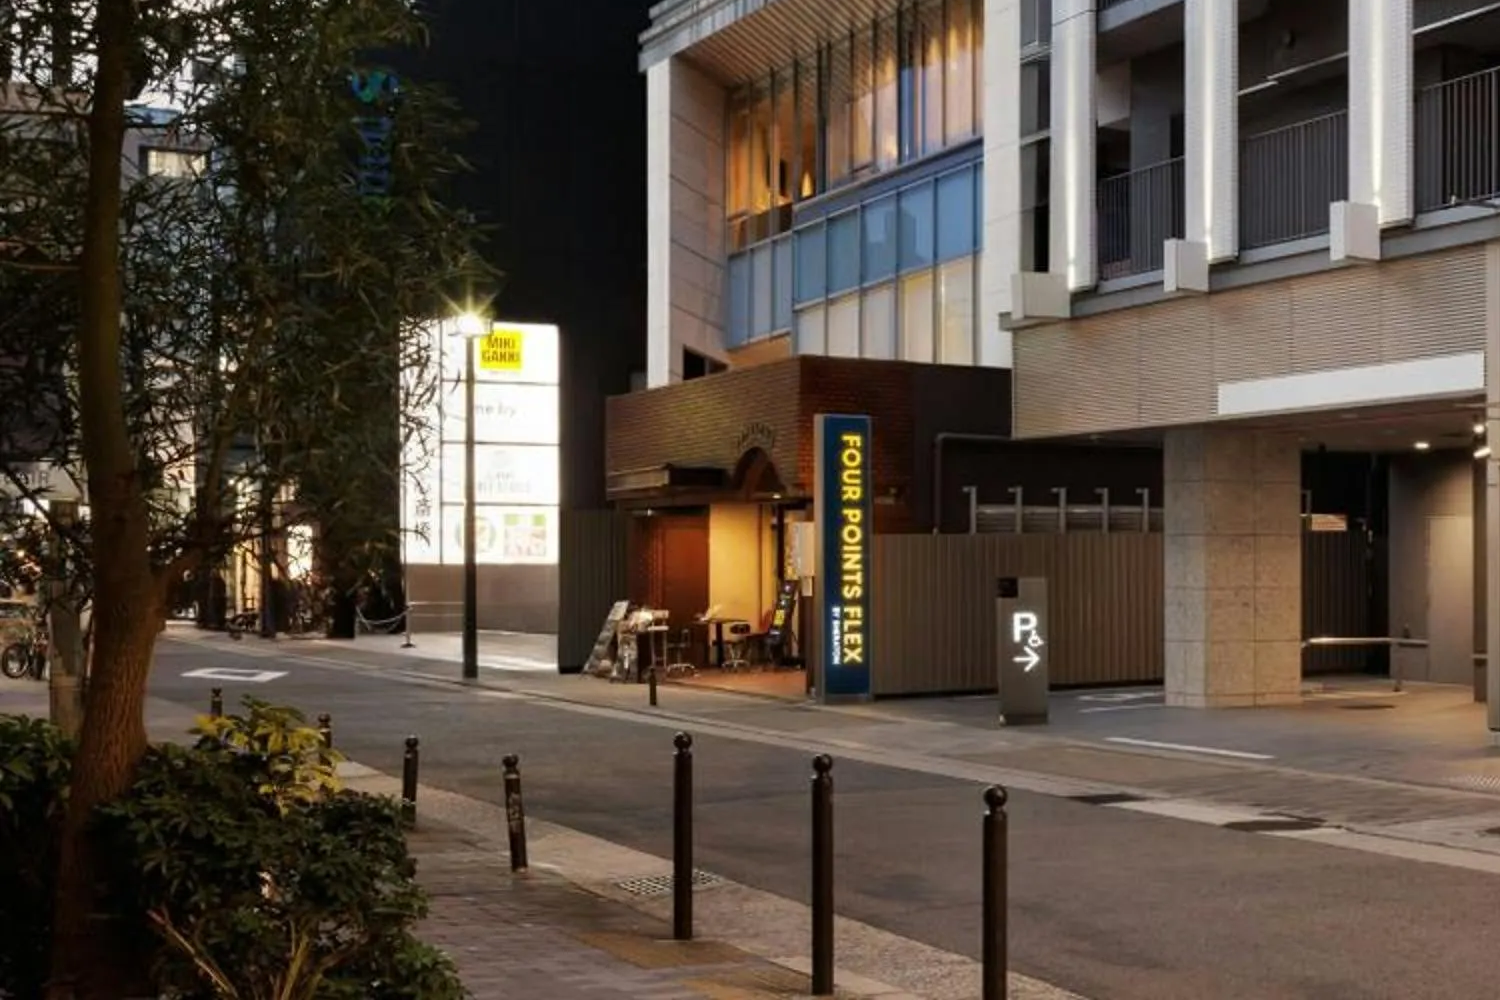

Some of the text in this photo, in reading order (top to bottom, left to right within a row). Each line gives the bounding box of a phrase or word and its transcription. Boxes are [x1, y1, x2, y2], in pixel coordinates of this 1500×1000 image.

[841, 433, 863, 664] FOUR POINTS FLEX
[1012, 611, 1038, 643] P
